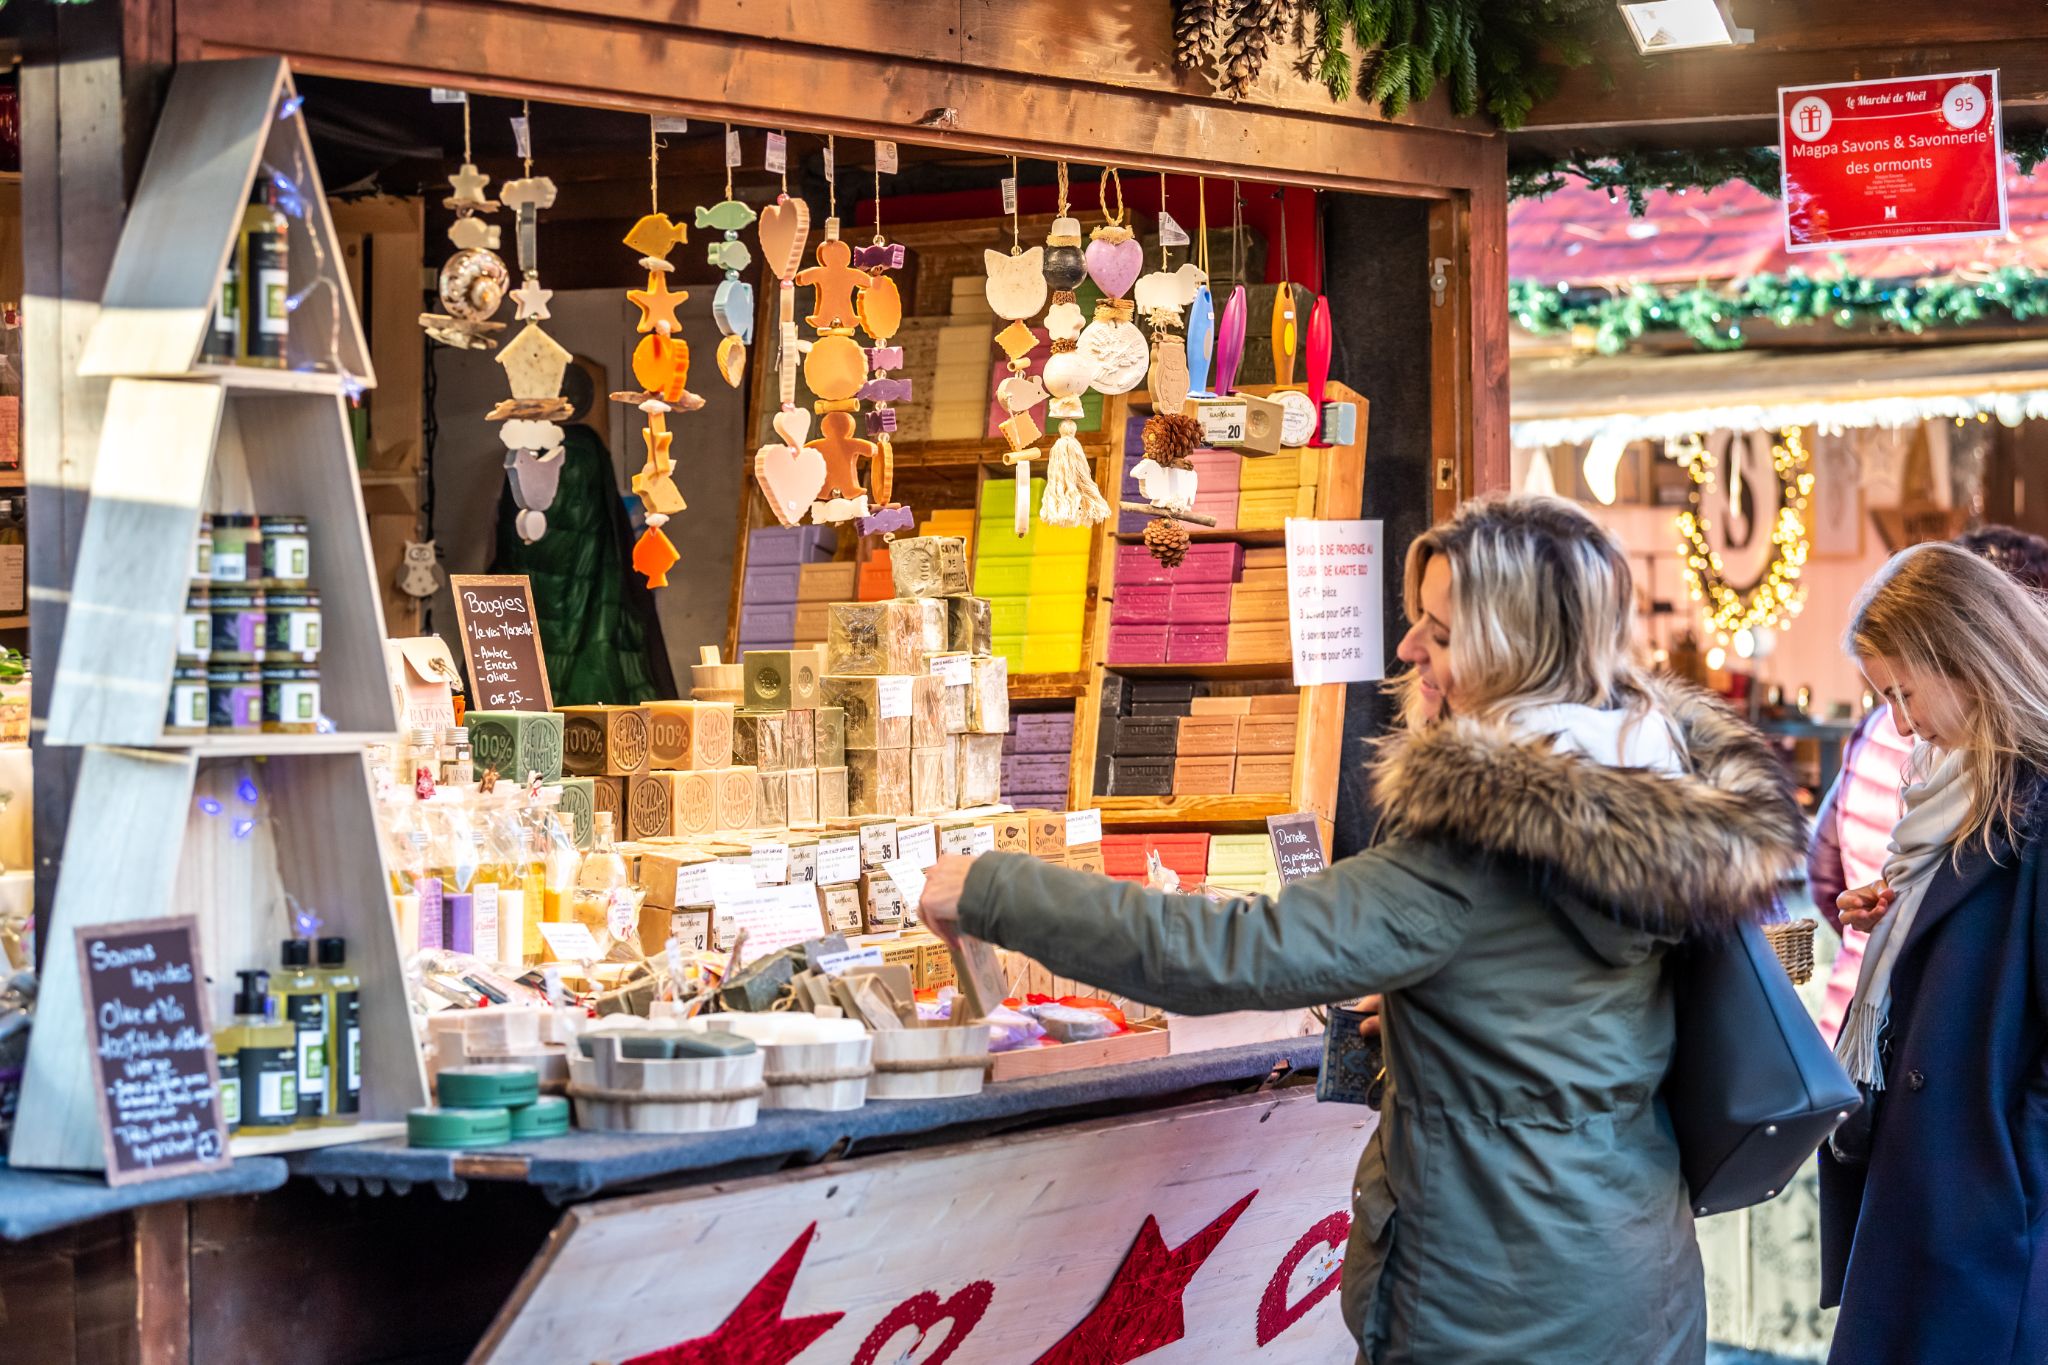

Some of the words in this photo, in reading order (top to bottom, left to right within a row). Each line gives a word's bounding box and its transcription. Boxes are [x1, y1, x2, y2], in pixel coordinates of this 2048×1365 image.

[1846, 96, 1856, 110] Le
[1857, 92, 1890, 106] Marché
[1892, 92, 1904, 104] de
[1905, 90, 1926, 103] Noël
[1954, 97, 1974, 112] 95
[1792, 144, 1838, 159] Magpa
[1842, 138, 1890, 153] Savons
[1893, 136, 1904, 149] &
[1909, 130, 1987, 148] Savonnerie
[1846, 161, 1870, 175] des
[1873, 156, 1932, 172] ormonts
[1228, 425, 1240, 438] 20
[1296, 544, 1326, 556] SAVOS
[1326, 544, 1334, 556] DE
[1336, 544, 1366, 556] PROVENCE
[1298, 565, 1320, 577] BEUR
[1324, 565, 1332, 576] DE
[464, 592, 526, 618] Bougies
[1300, 608, 1304, 619] 3
[1326, 611, 1340, 621] pour
[1340, 607, 1352, 618] CHF
[486, 627, 500, 638] vrai
[1328, 632, 1340, 642] pour
[1341, 628, 1352, 638] CHF
[1302, 650, 1306, 662] 9
[1328, 652, 1340, 664] pour
[1342, 648, 1353, 660] CHF
[650, 723, 688, 748] 100%
[1130, 726, 1167, 736] OPIUM
[473, 733, 512, 760] 100%
[564, 728, 603, 754] 100%
[1128, 766, 1163, 776] OPIUM
[646, 782, 663, 808] VRAI
[882, 844, 892, 859] 35
[1280, 850, 1292, 864] La
[805, 866, 814, 881] 20
[892, 900, 900, 916] 35
[849, 911, 858, 926] 35
[695, 934, 704, 950] 12
[90, 940, 156, 971] Savons
